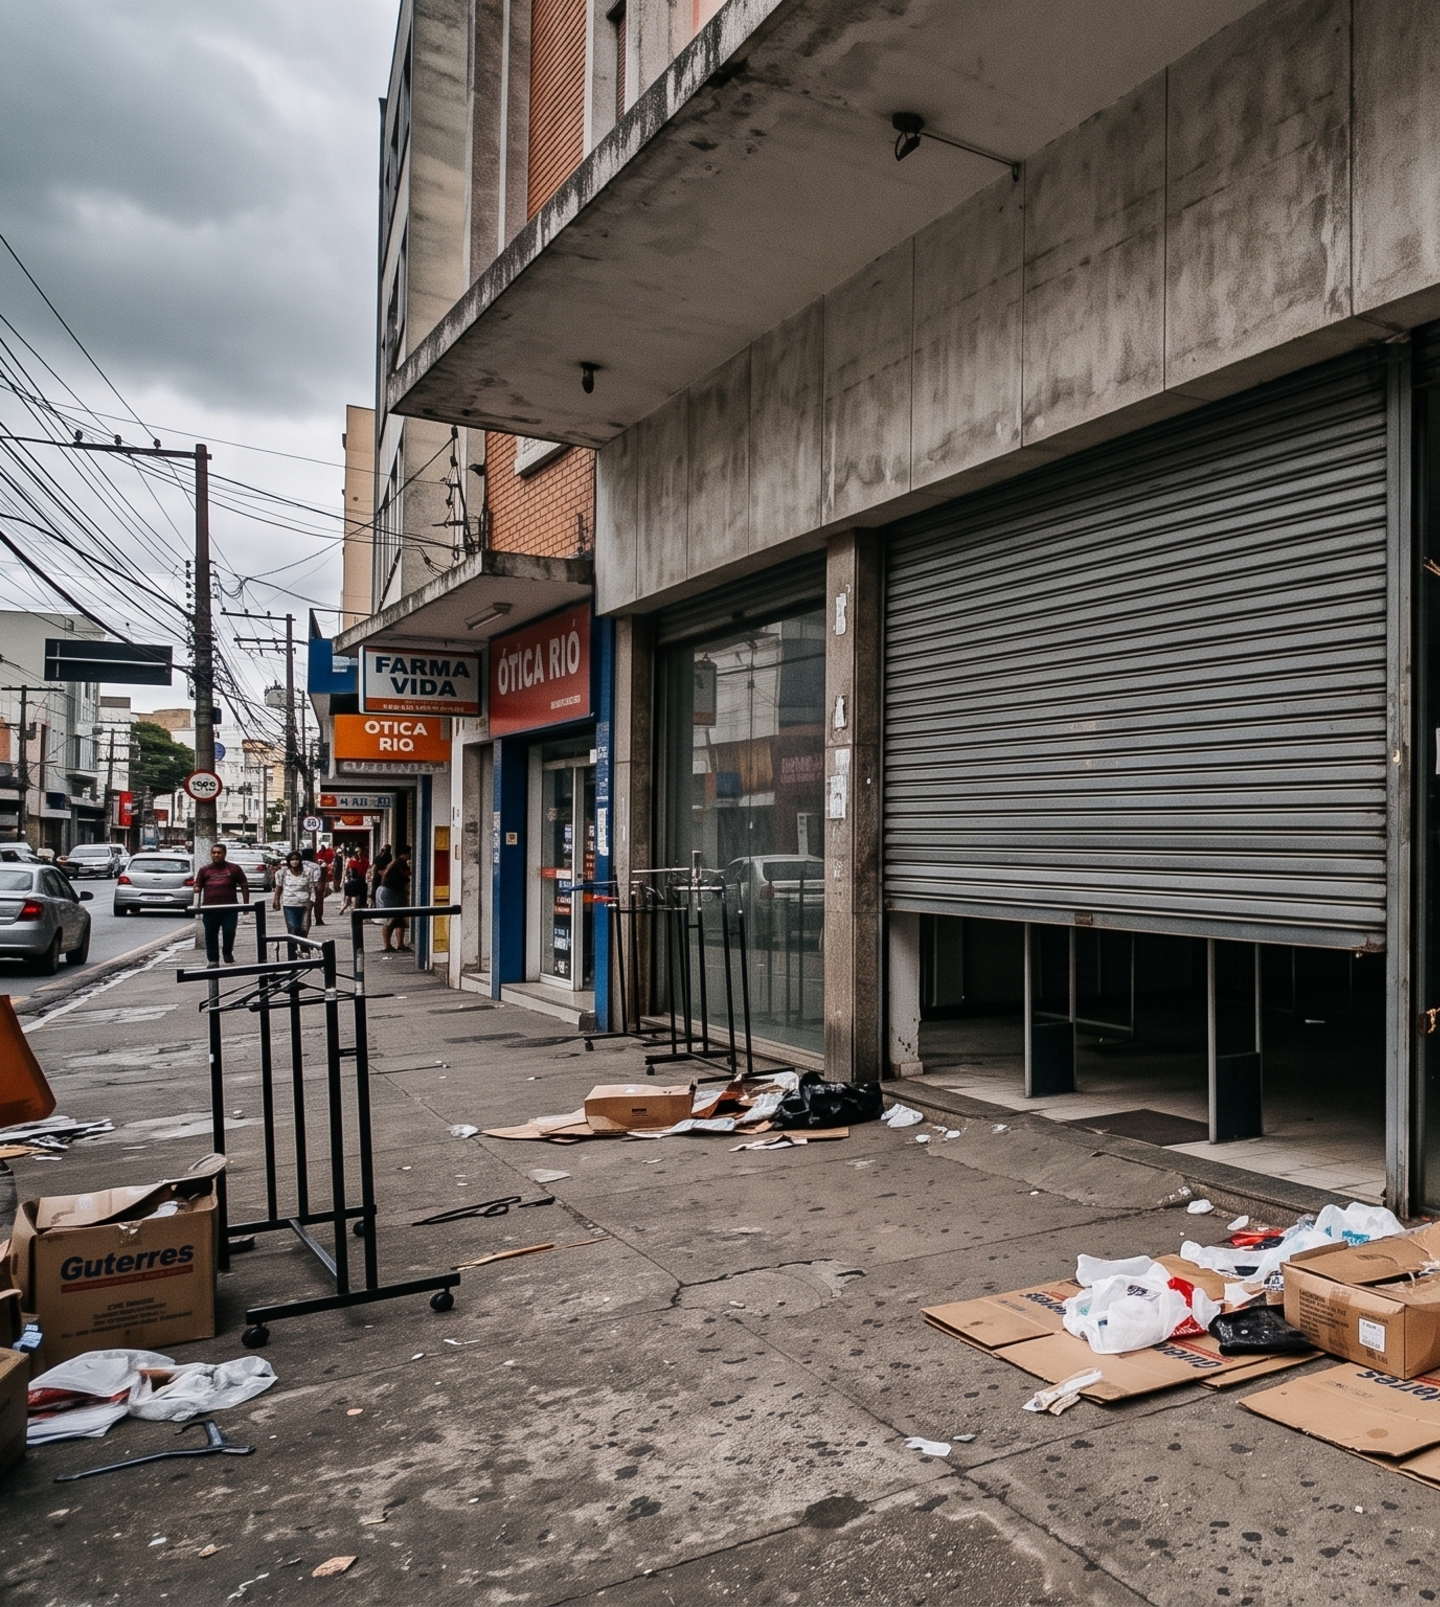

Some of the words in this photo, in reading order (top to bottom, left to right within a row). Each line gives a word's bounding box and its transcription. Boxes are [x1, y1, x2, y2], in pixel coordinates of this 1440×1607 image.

[375, 656, 471, 679] FARMA
[389, 676, 458, 698] VIDA
[60, 1245, 194, 1281] Guterres
